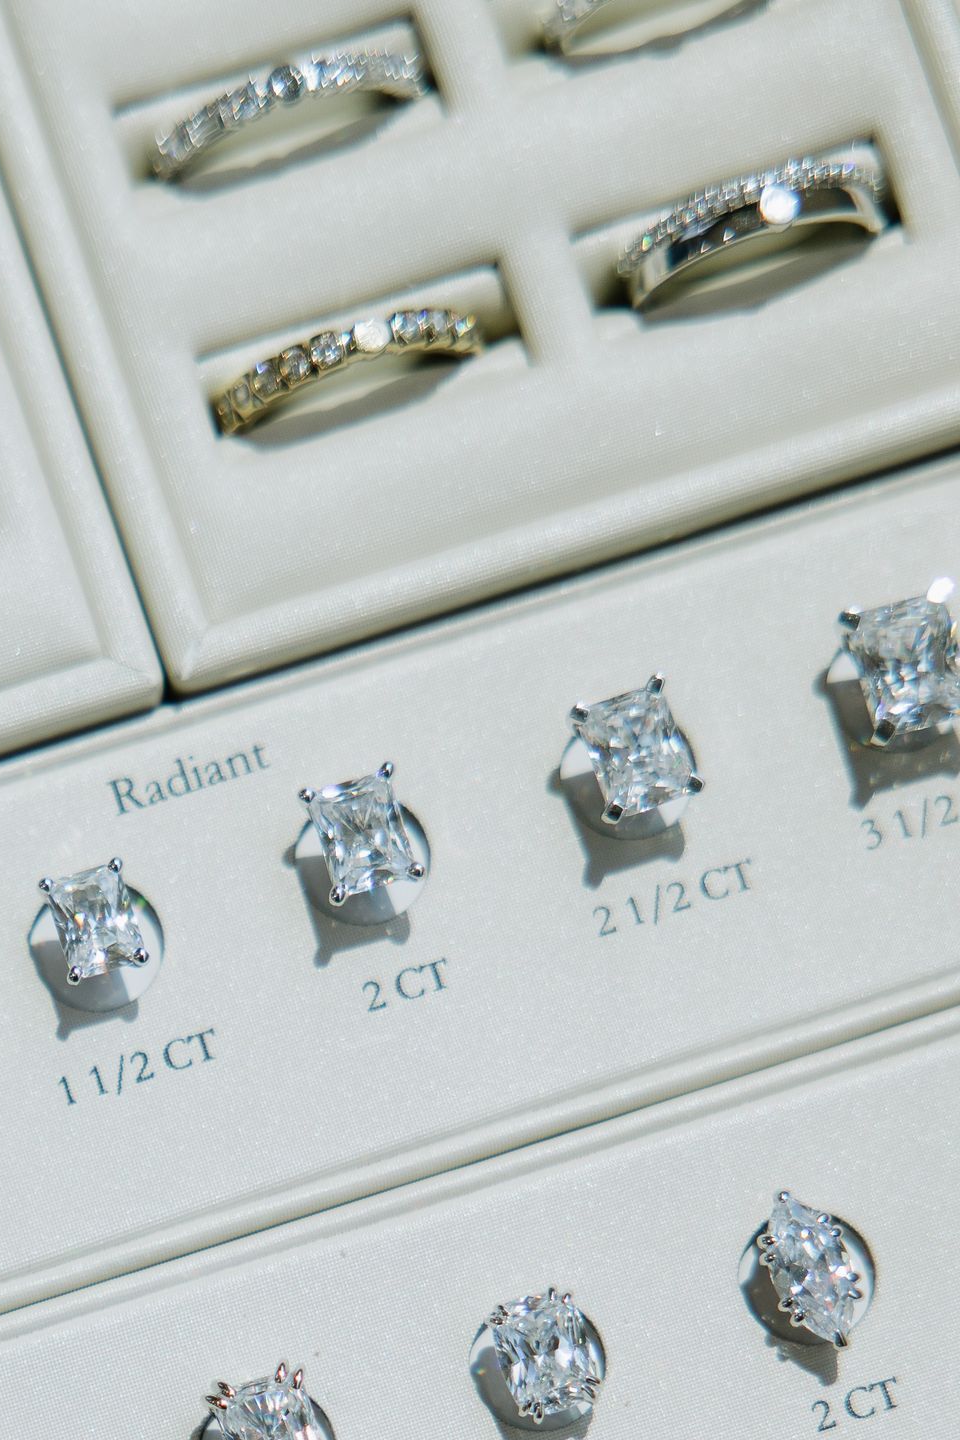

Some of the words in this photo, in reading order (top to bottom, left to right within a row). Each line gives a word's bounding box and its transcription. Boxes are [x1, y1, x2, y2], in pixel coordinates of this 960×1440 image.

[107, 743, 270, 815] Radiant
[861, 818, 884, 851] 3
[895, 795, 959, 838] 1/2
[593, 905, 618, 938] 2
[627, 881, 692, 925] 1/2
[700, 857, 752, 901] CT
[362, 979, 387, 1012] 2
[395, 956, 448, 1000] CT
[58, 1075, 77, 1106] 1
[89, 1050, 156, 1096] 1/2
[163, 1028, 216, 1071] CT
[811, 1399, 838, 1433] 2
[844, 1375, 899, 1420] CT
